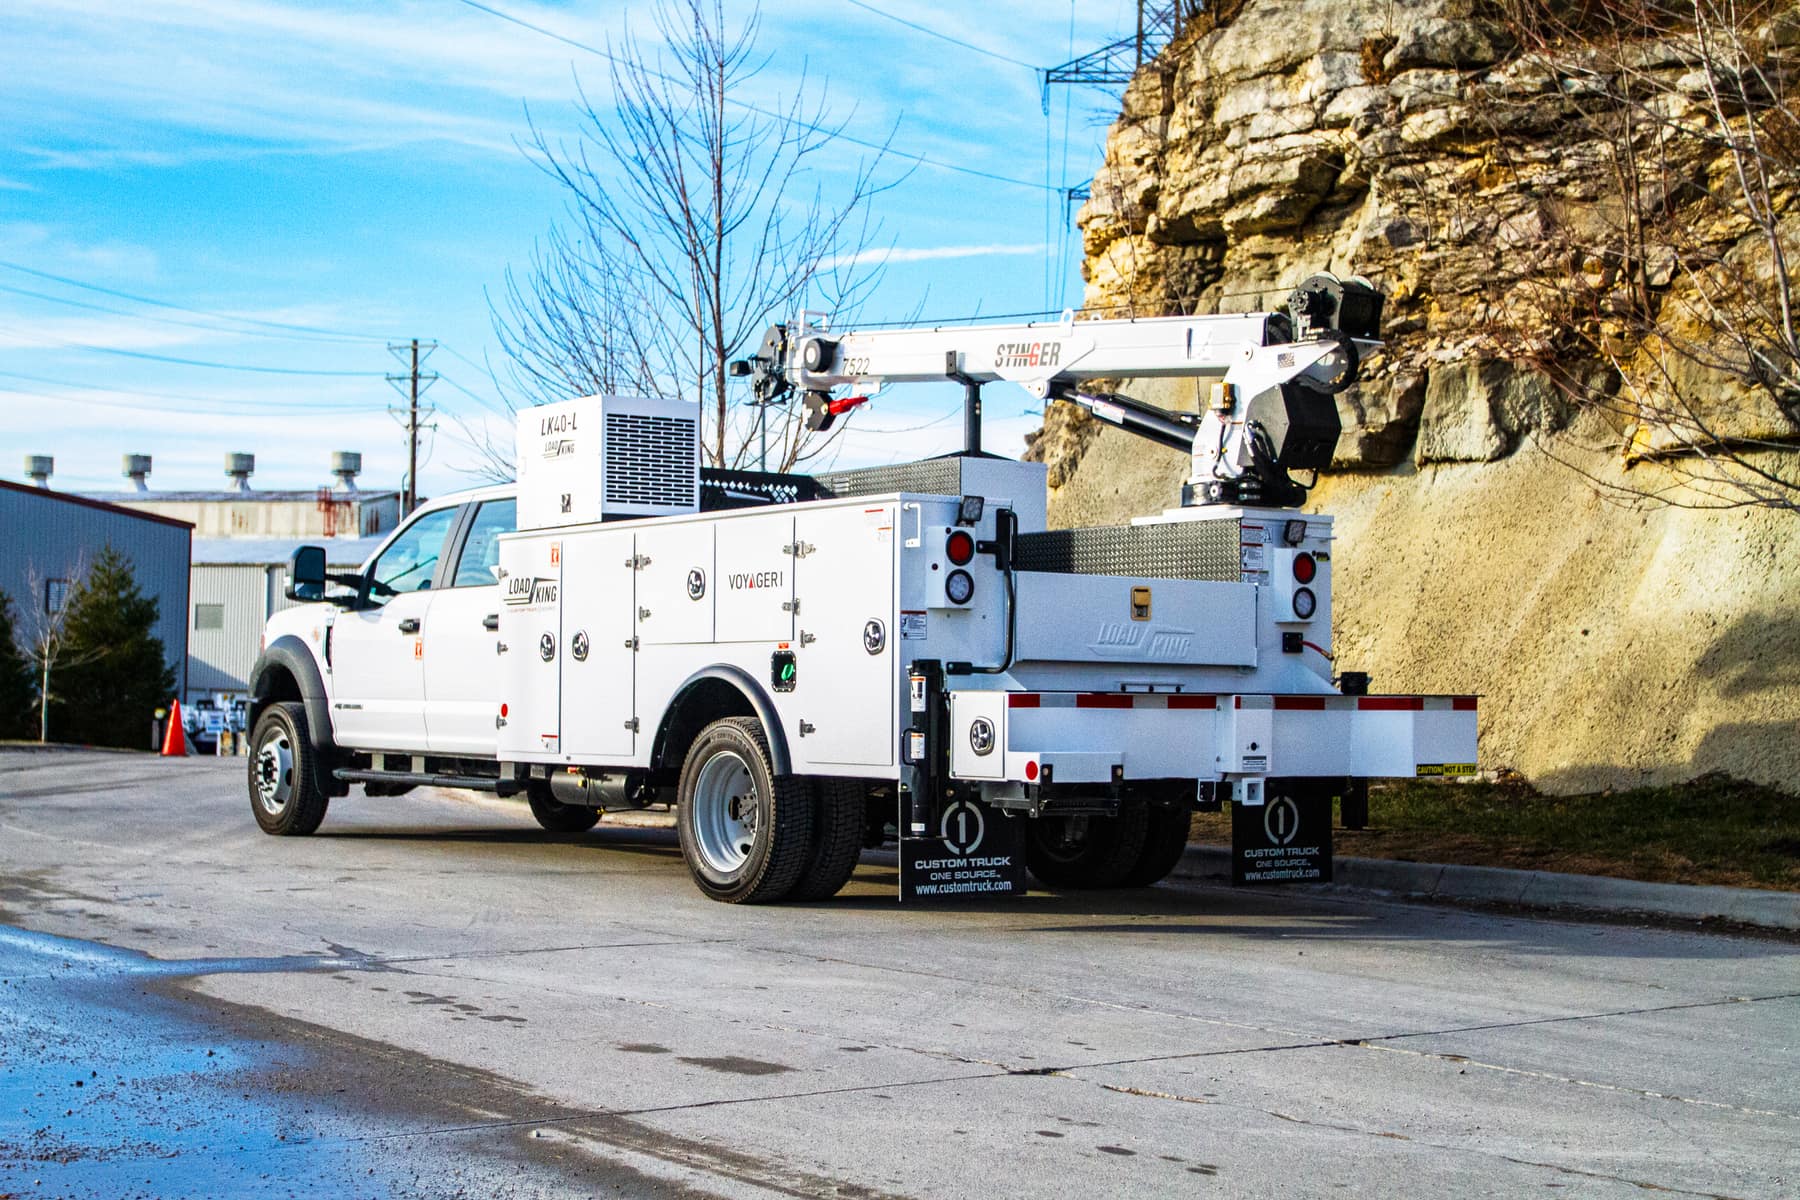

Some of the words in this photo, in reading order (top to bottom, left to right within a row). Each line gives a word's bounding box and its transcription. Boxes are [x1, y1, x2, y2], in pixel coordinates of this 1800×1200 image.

[995, 342, 1061, 367] STINGER
[843, 357, 869, 376] 7522
[541, 412, 577, 436] LK40-L
[728, 571, 778, 590] VOYAGER
[509, 577, 531, 595] LOAD
[535, 585, 557, 603] KING
[1097, 623, 1139, 646] LOAD
[1147, 635, 1191, 658] KING
[1444, 766, 1456, 774] NOT
[1244, 848, 1285, 858] CUSTOM
[1286, 846, 1320, 856] TRUCK
[915, 858, 967, 870] CUSTOM
[969, 856, 1011, 867] TRUCK
[1256, 859, 1273, 868] ONE
[930, 871, 952, 880] ONE
[1245, 867, 1320, 881] www.customtruck.com
[916, 880, 1012, 895] www.customtruck.com
